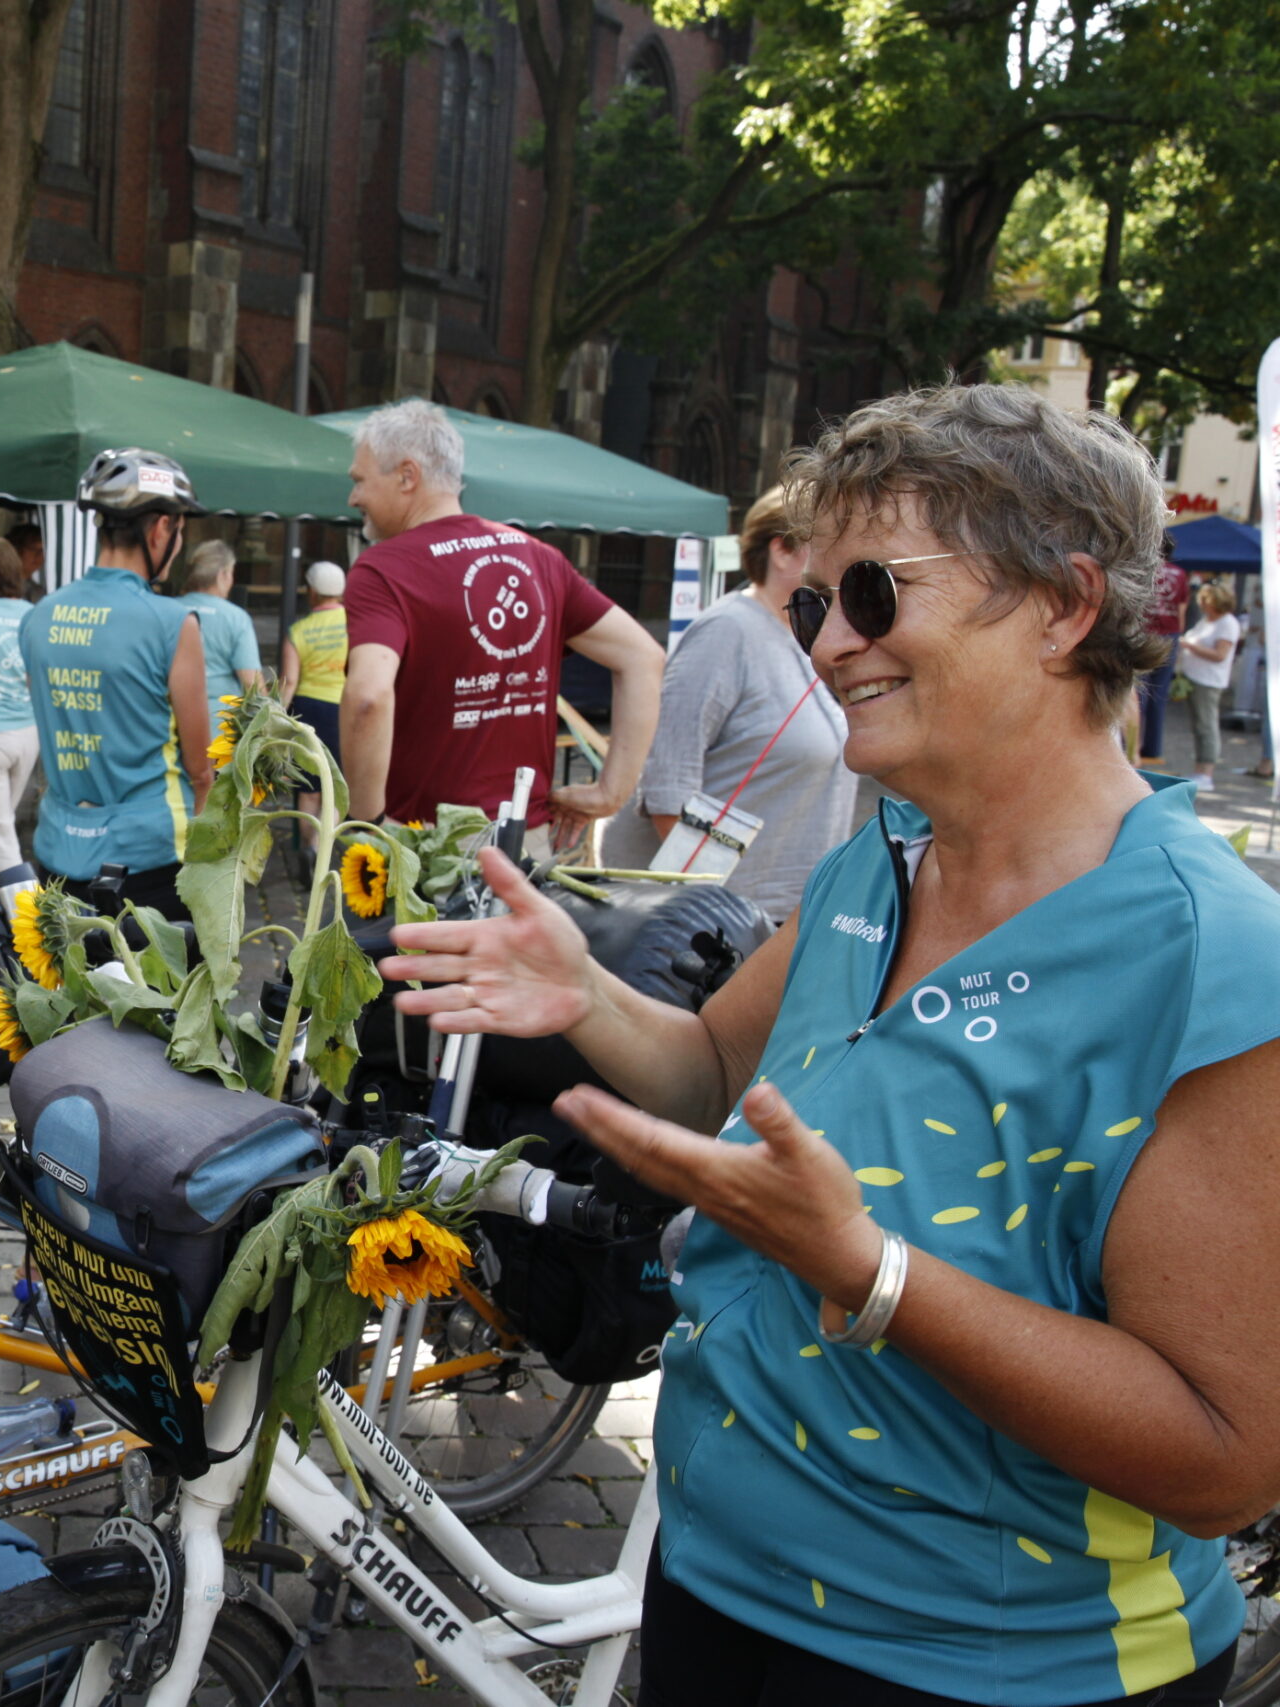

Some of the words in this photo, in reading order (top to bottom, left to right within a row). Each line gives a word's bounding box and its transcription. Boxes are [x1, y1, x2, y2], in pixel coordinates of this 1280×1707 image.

[428, 533, 498, 558] MUT-TOUR
[51, 604, 112, 625] MACHT
[48, 625, 94, 647] SINN!
[47, 667, 102, 689] MACHT
[51, 689, 103, 712] SPASS!
[959, 971, 992, 990] MUT
[961, 991, 1001, 1011] TOUR
[38, 1155, 63, 1178] ORTLIEB
[72, 1240, 107, 1279] Mut
[330, 1518, 463, 1644] SCHAUFF
